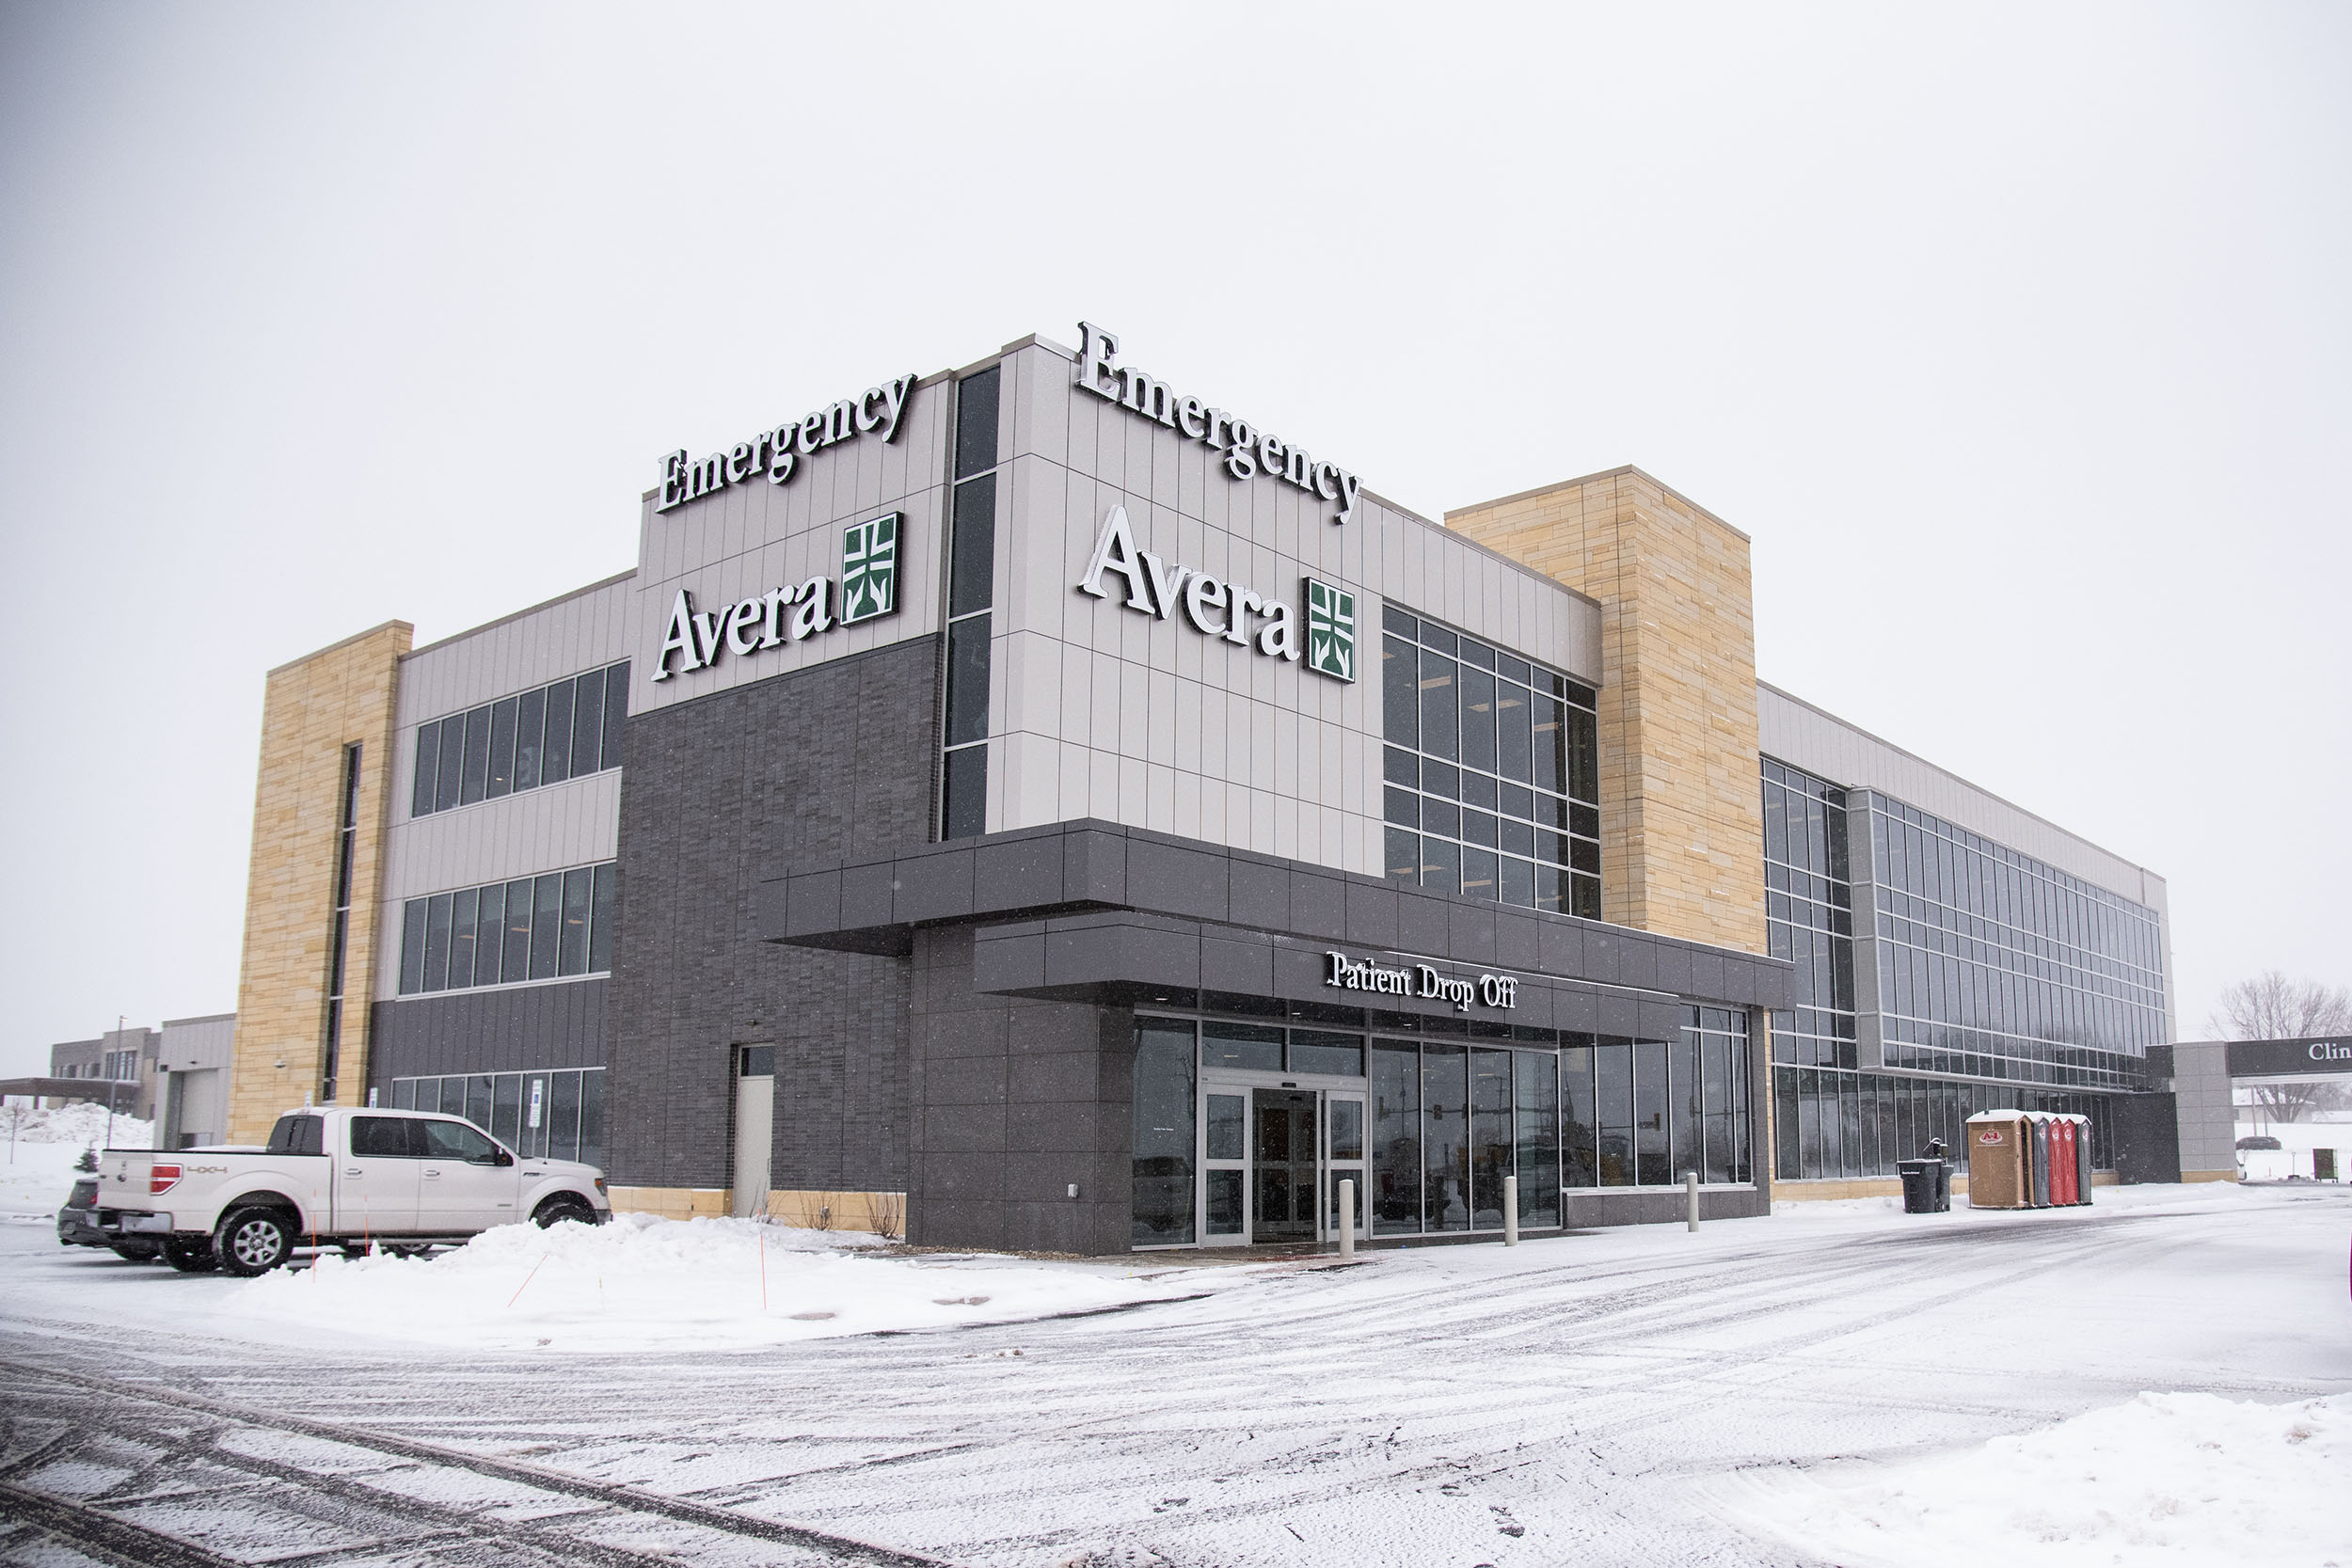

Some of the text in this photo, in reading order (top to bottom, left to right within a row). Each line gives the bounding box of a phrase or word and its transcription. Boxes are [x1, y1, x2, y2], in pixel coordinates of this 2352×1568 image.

[655, 373, 917, 514] Emergency
[1076, 320, 1364, 525] Emergency
[650, 576, 836, 682] Avera
[1077, 504, 1301, 662] Avera
[1326, 950, 1519, 1013] Patient Drop Off
[2308, 1042, 2352, 1061] Clin
